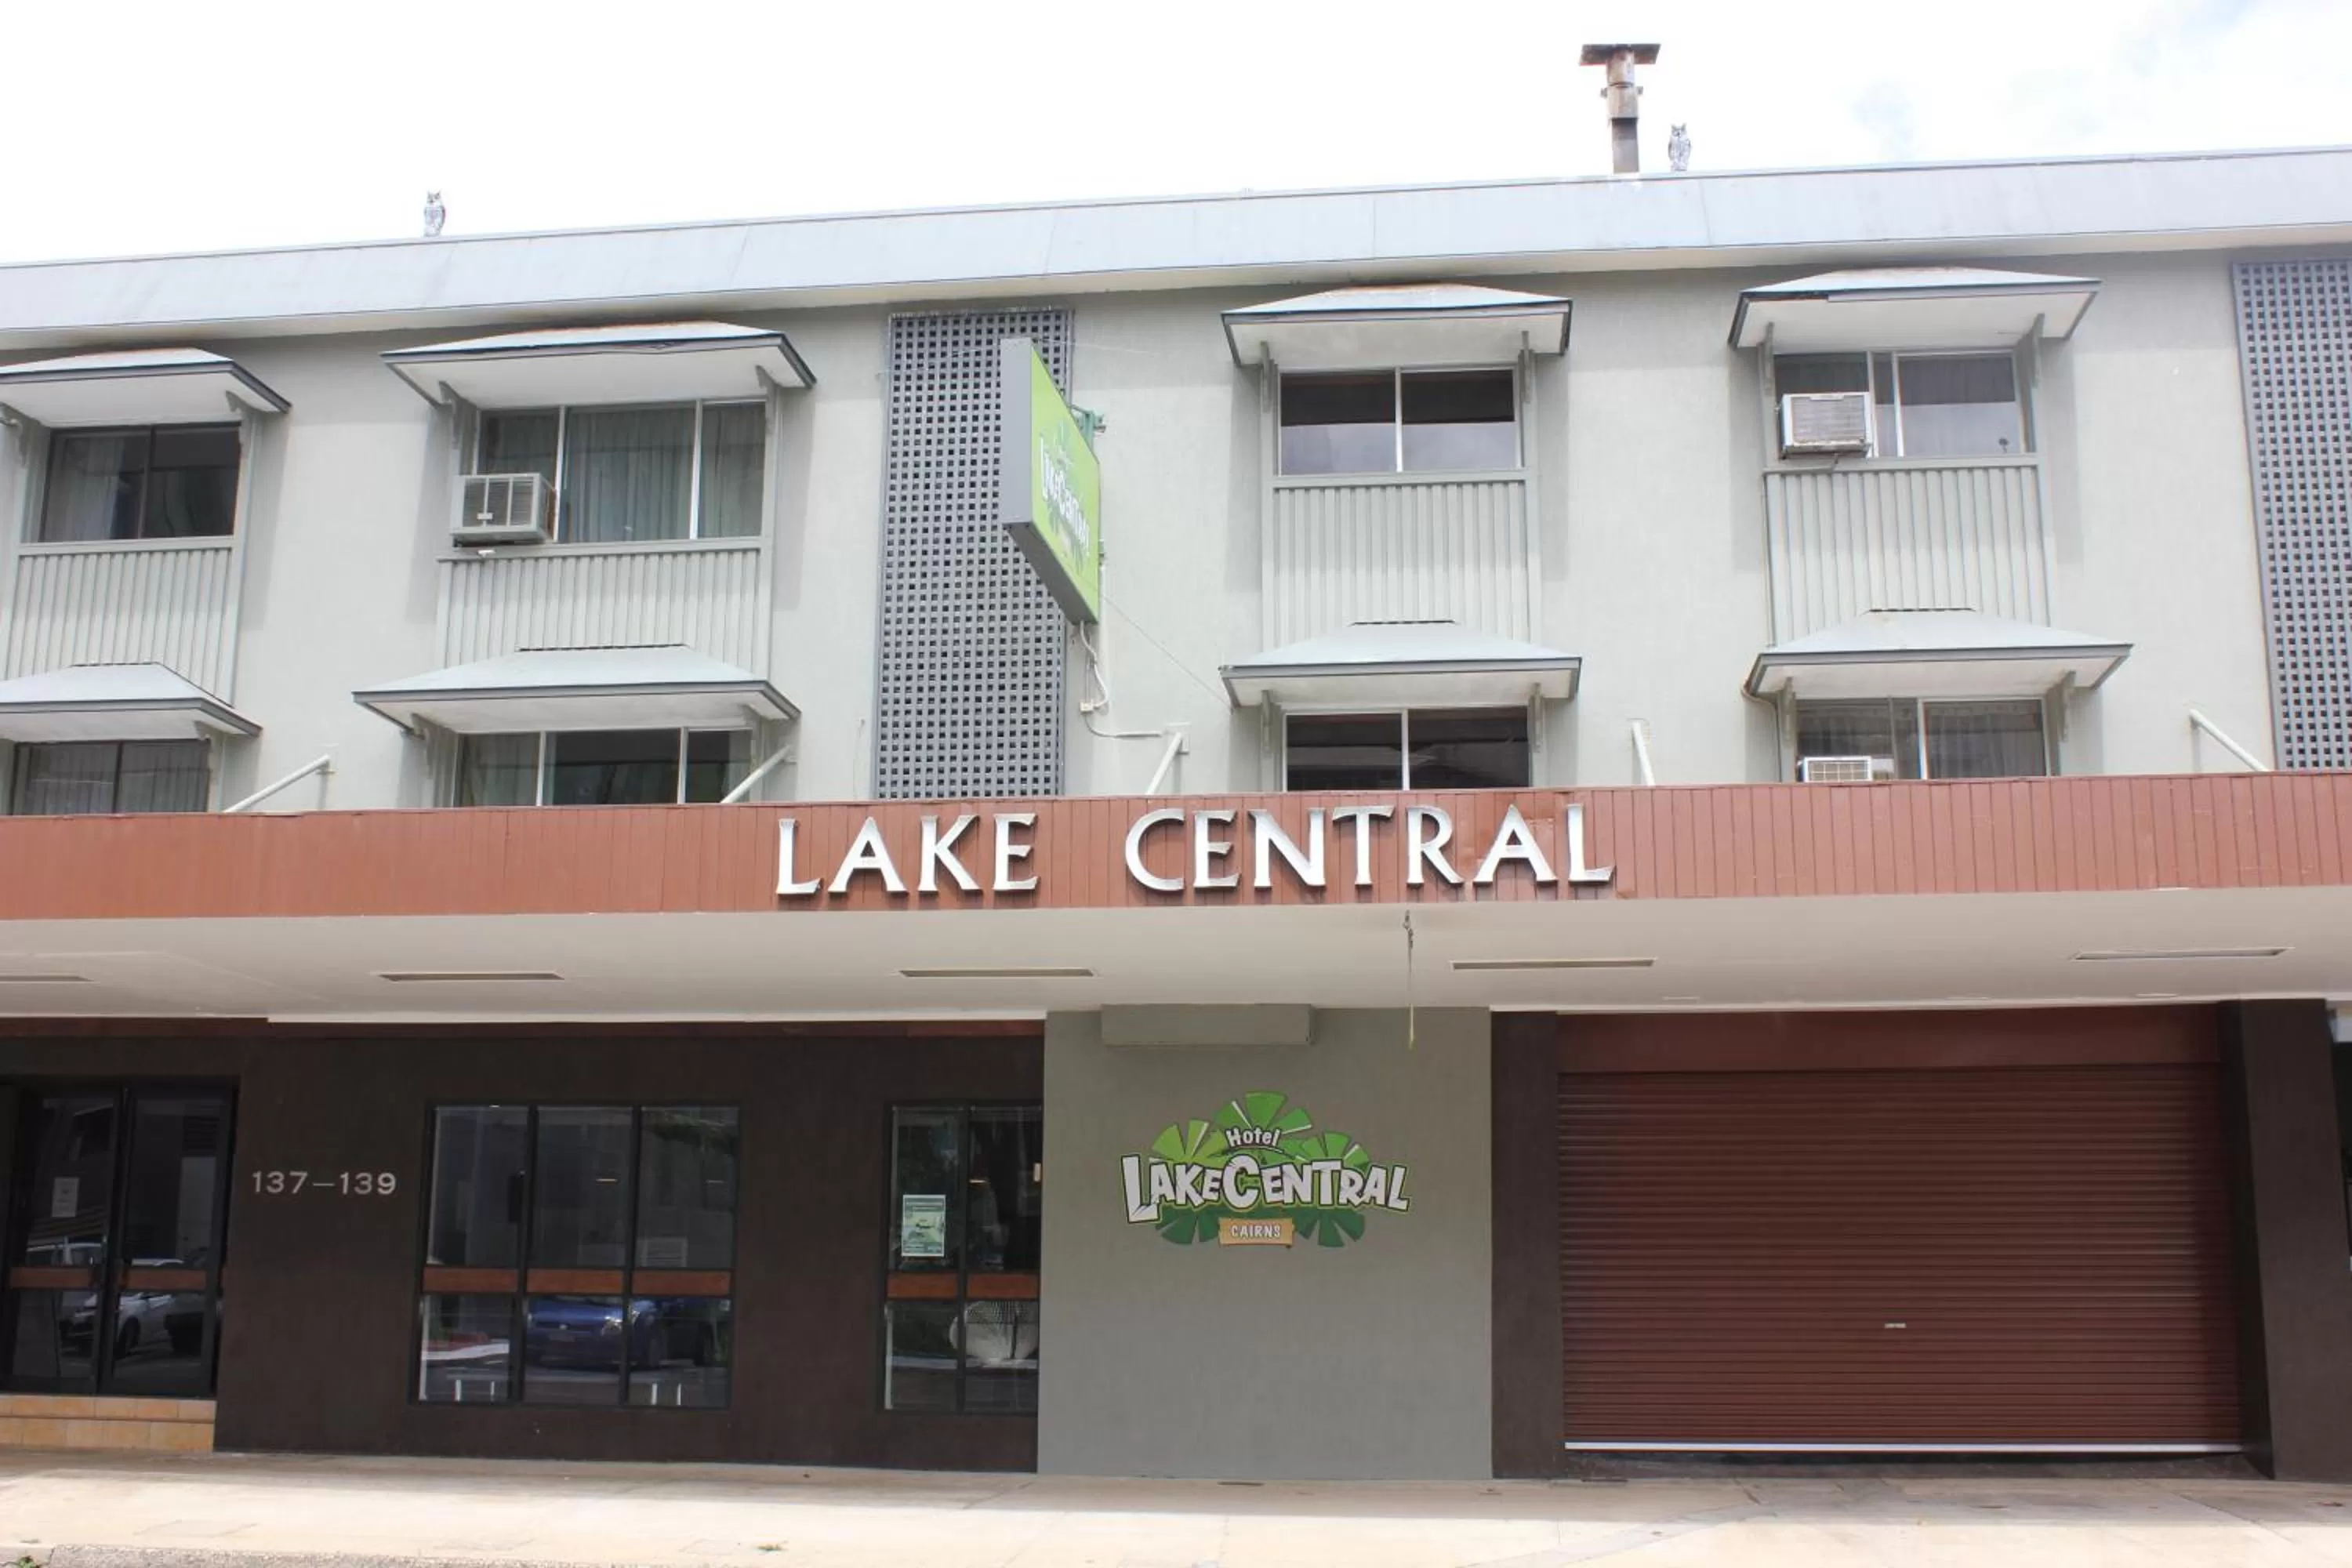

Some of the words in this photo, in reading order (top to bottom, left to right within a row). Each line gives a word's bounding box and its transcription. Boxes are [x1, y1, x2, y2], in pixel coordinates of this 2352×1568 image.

[776, 813, 1040, 895] LAKE
[1124, 804, 1616, 891] CENTRAL
[1225, 1127, 1282, 1148] Hotel
[1232, 1225, 1281, 1239] CAIRNS
